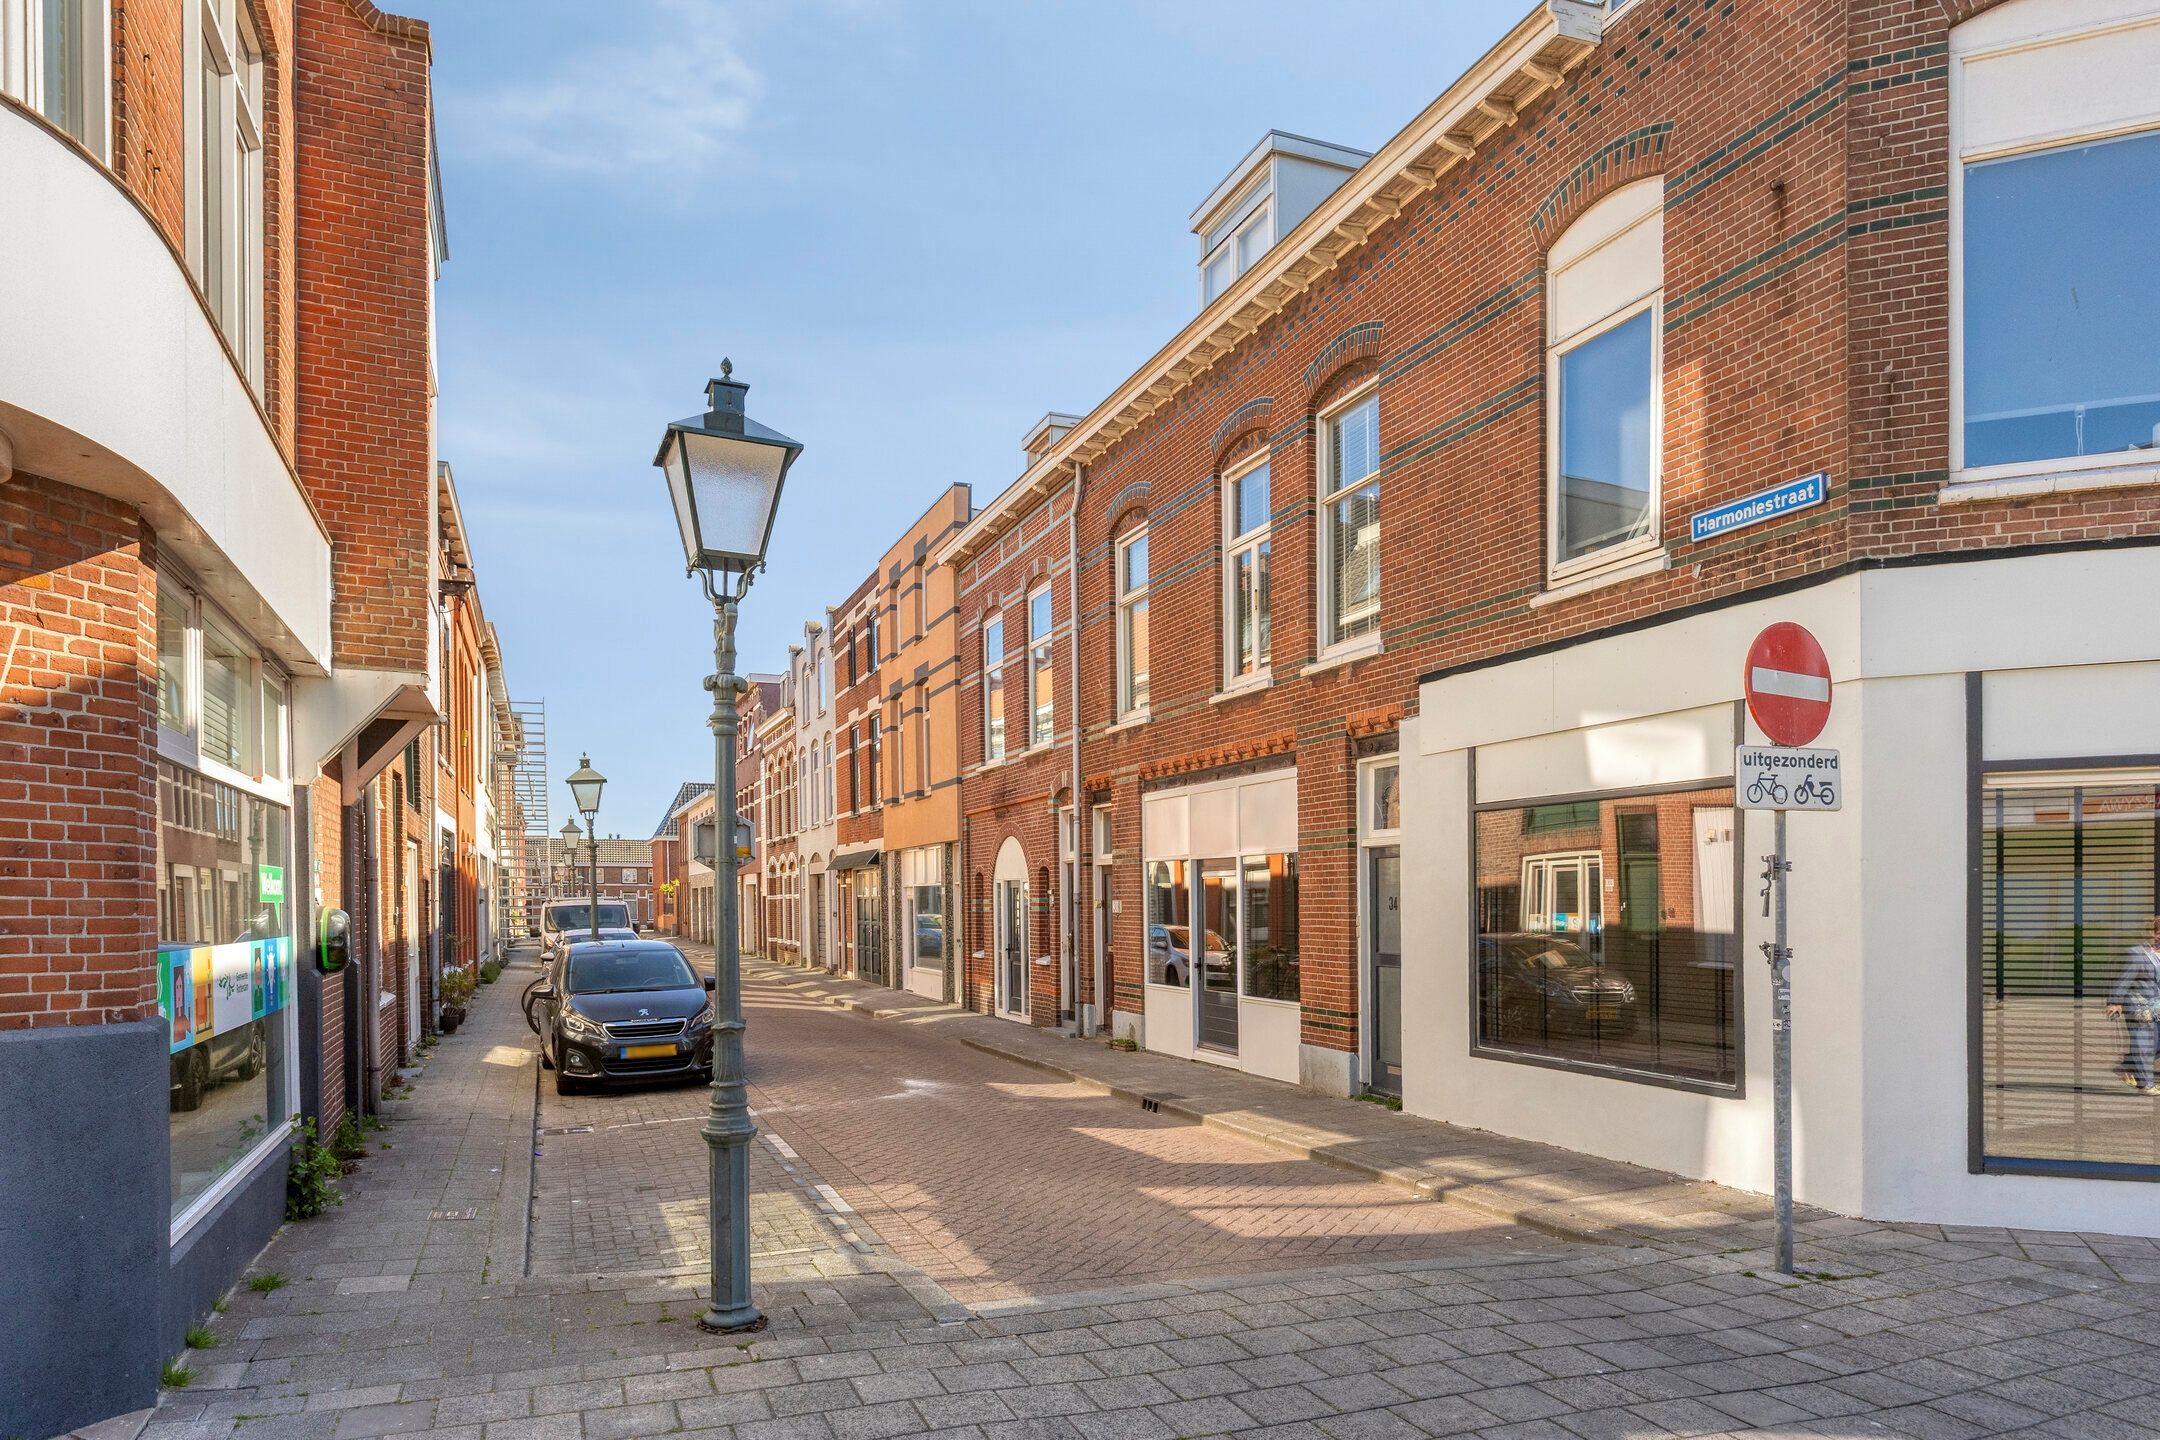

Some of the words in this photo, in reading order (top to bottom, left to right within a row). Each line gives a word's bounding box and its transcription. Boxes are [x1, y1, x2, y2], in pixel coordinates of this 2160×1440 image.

[1697, 482, 1814, 534] Harmoniestraat
[1743, 752, 1838, 771] uitgezonderd
[1388, 896, 1398, 911] 34
